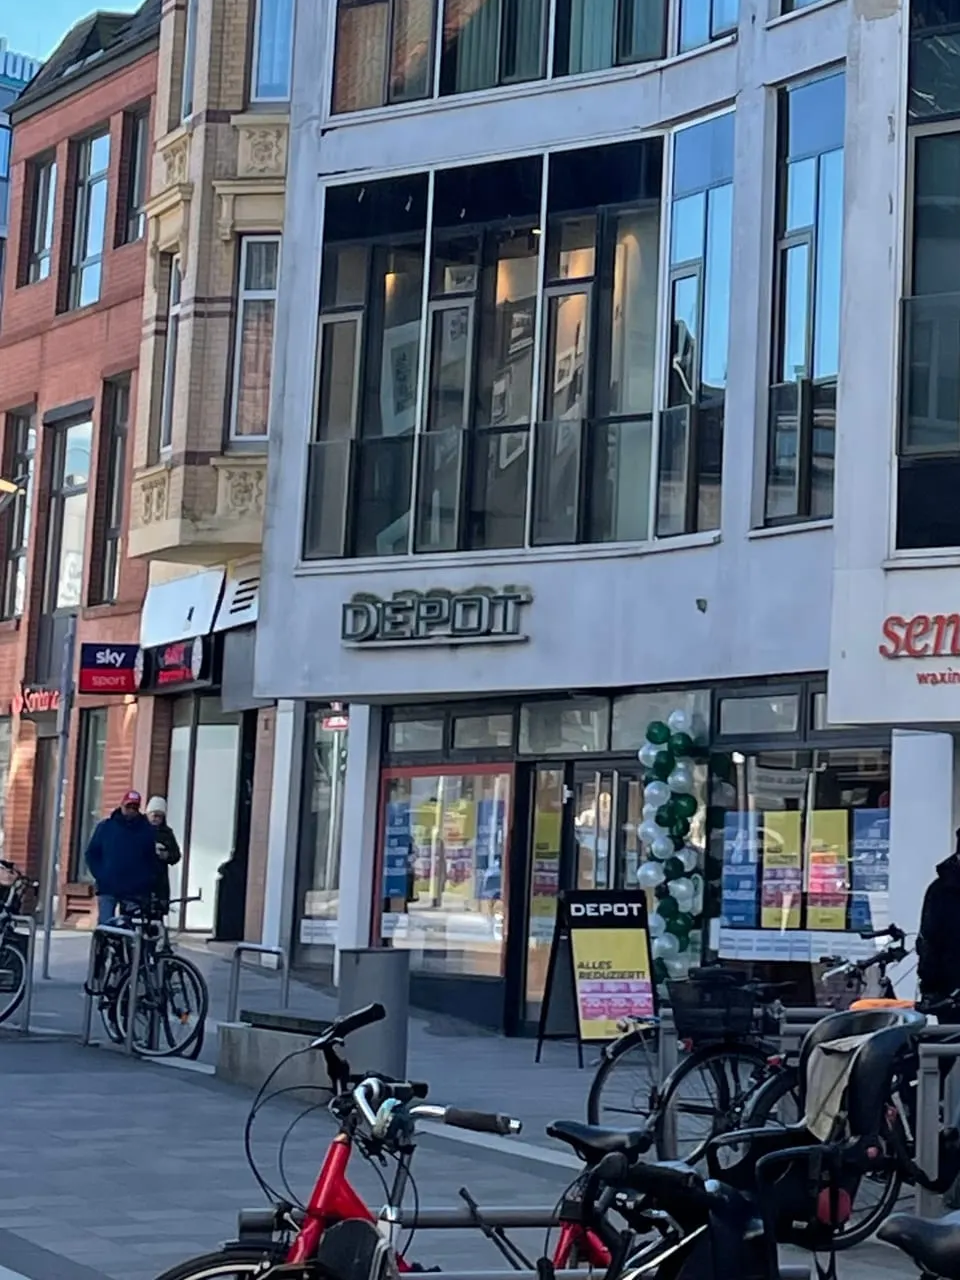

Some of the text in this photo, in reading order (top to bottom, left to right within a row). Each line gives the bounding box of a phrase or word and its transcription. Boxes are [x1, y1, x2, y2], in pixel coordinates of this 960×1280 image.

[341, 588, 533, 642] DEPOT
[96, 648, 125, 667] sky
[92, 675, 126, 688] sport
[570, 903, 642, 917] DEPOT
[577, 961, 612, 970] ALLES
